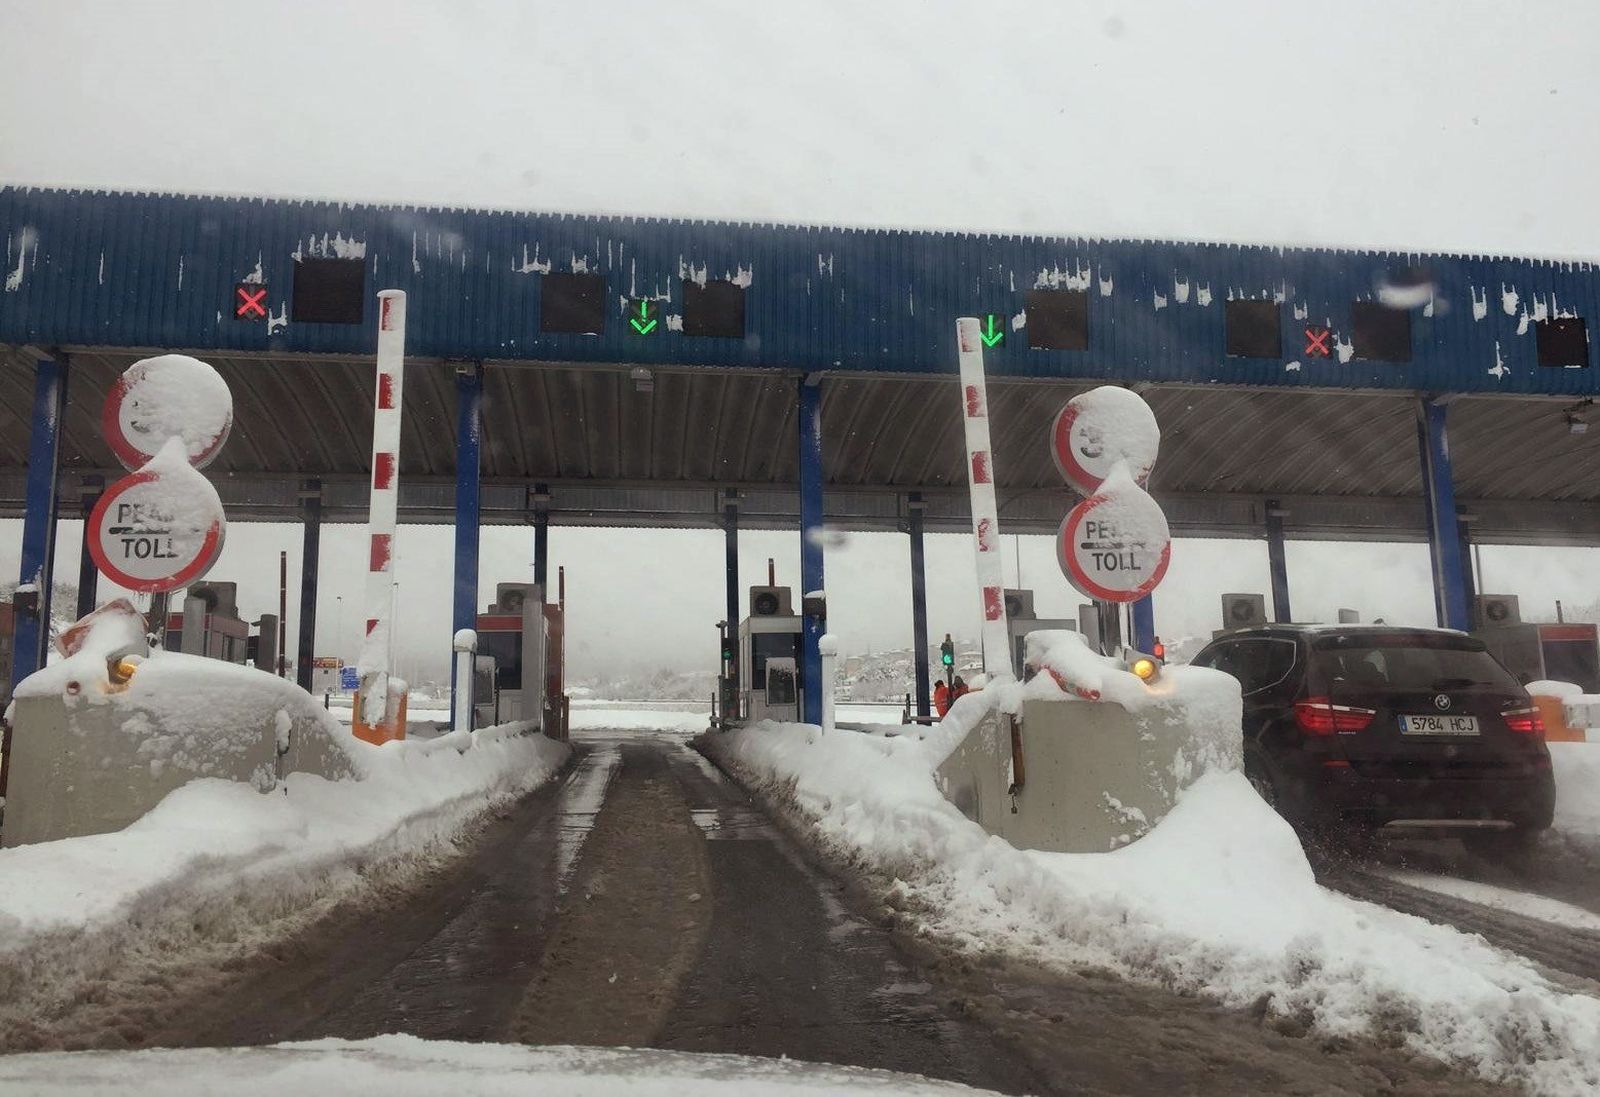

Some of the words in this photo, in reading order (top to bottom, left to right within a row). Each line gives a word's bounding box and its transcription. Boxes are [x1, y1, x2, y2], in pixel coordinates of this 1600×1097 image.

[121, 538, 178, 559] TOLL
[1092, 552, 1141, 571] TOLL
[1411, 717, 1443, 730] 5784
[1449, 718, 1474, 731] HCJ
